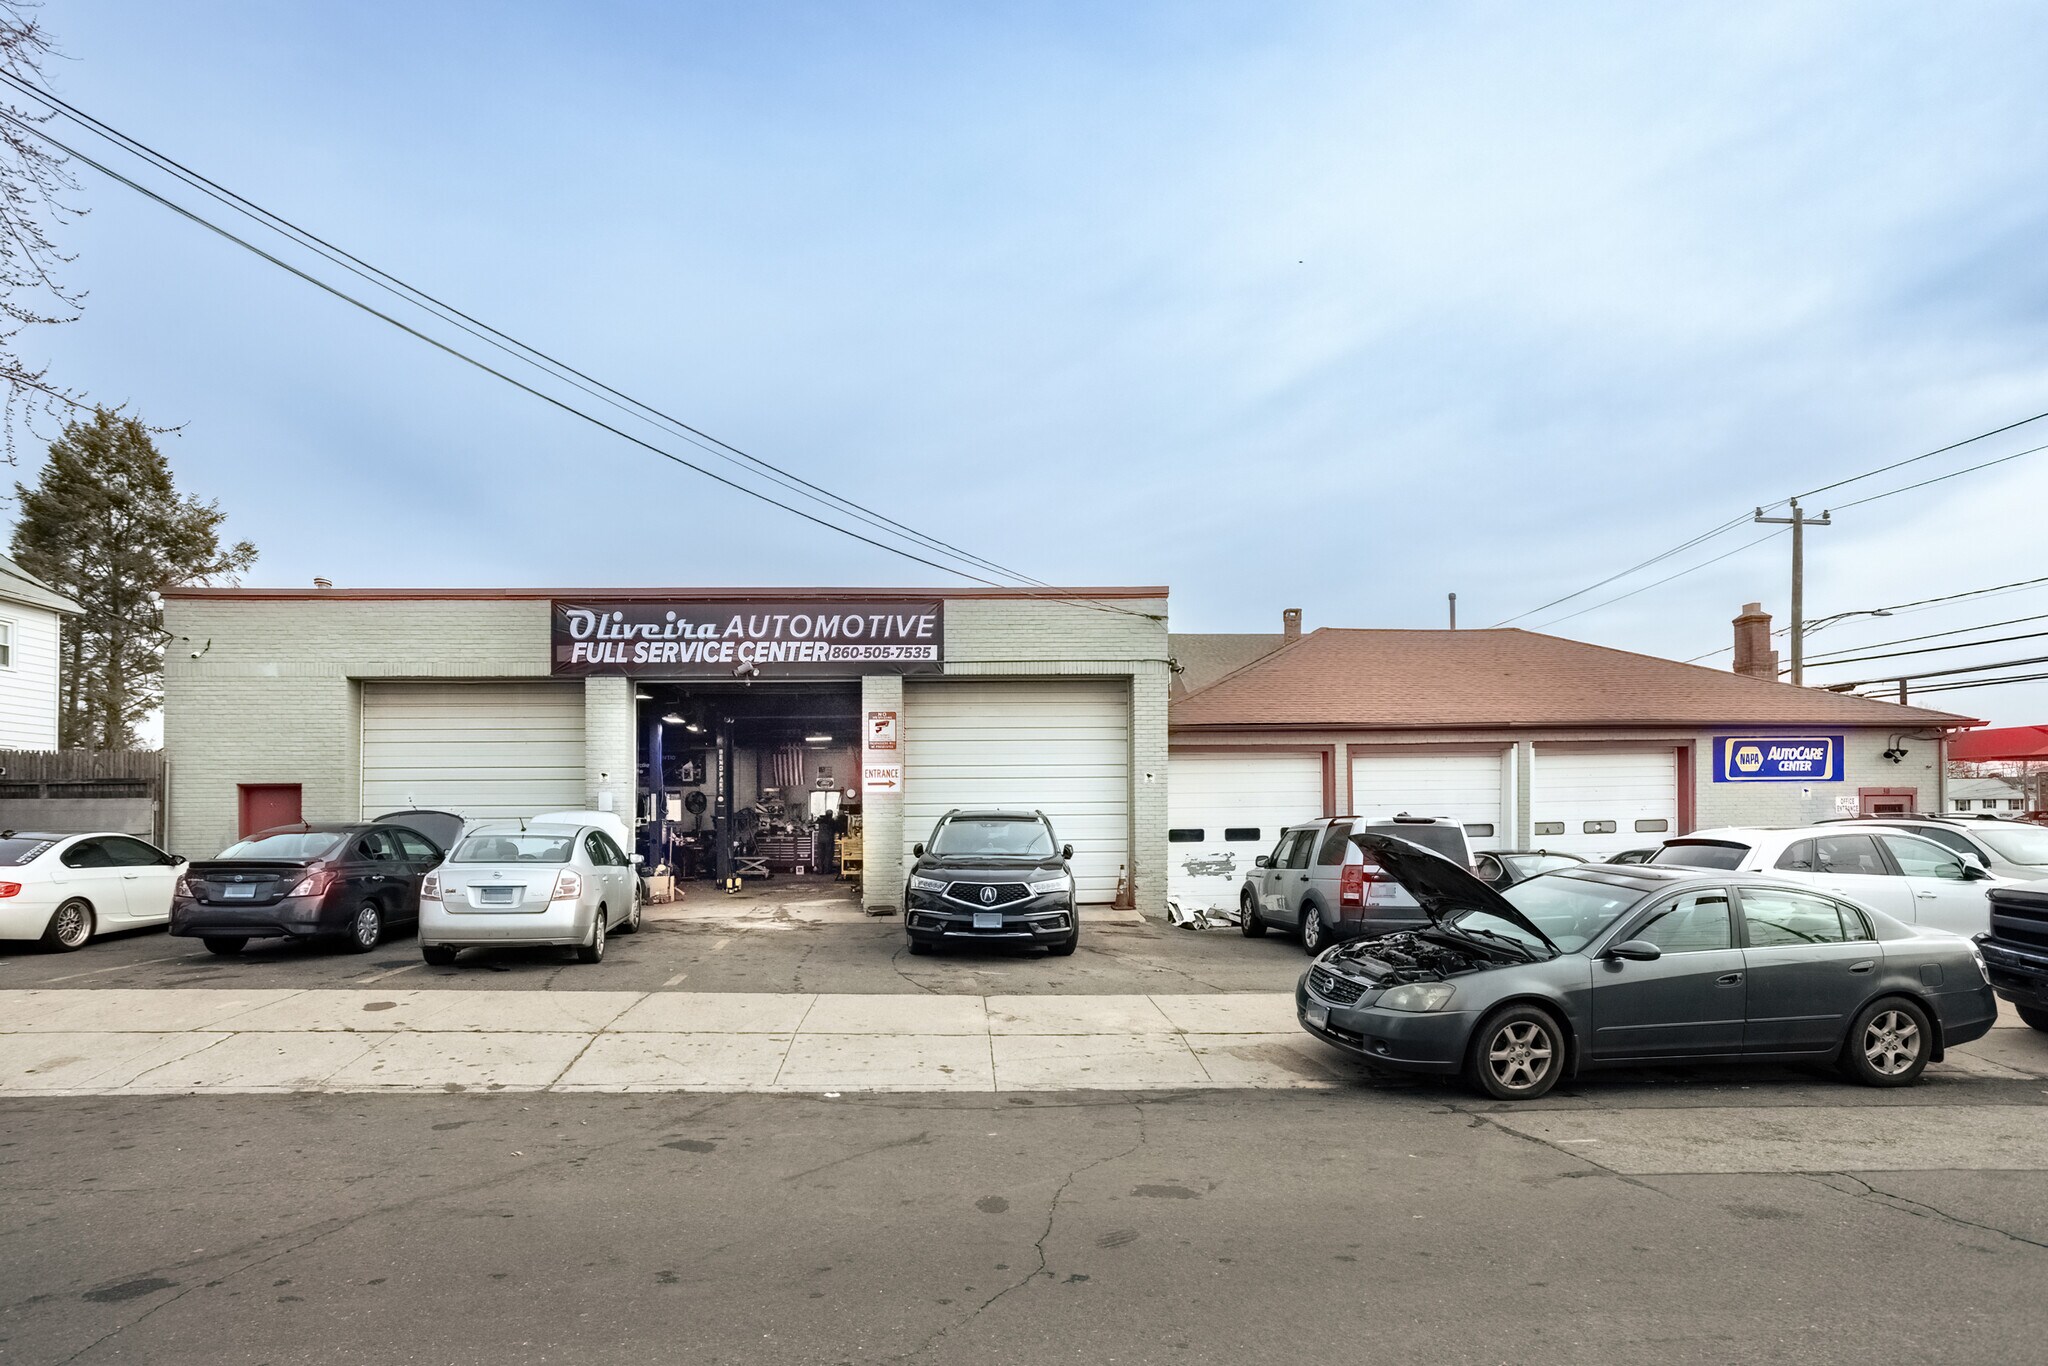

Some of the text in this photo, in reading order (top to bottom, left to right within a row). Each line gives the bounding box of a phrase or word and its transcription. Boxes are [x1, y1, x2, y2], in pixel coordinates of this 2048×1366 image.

[566, 610, 936, 639] Oliveira AUTOMOTIVE
[571, 641, 932, 663] FULL SERVICE CENTER 860-505-7535
[1740, 753, 1760, 765] NAPA
[1778, 760, 1812, 772] CENTER
[865, 768, 899, 779] ENTRANCE
